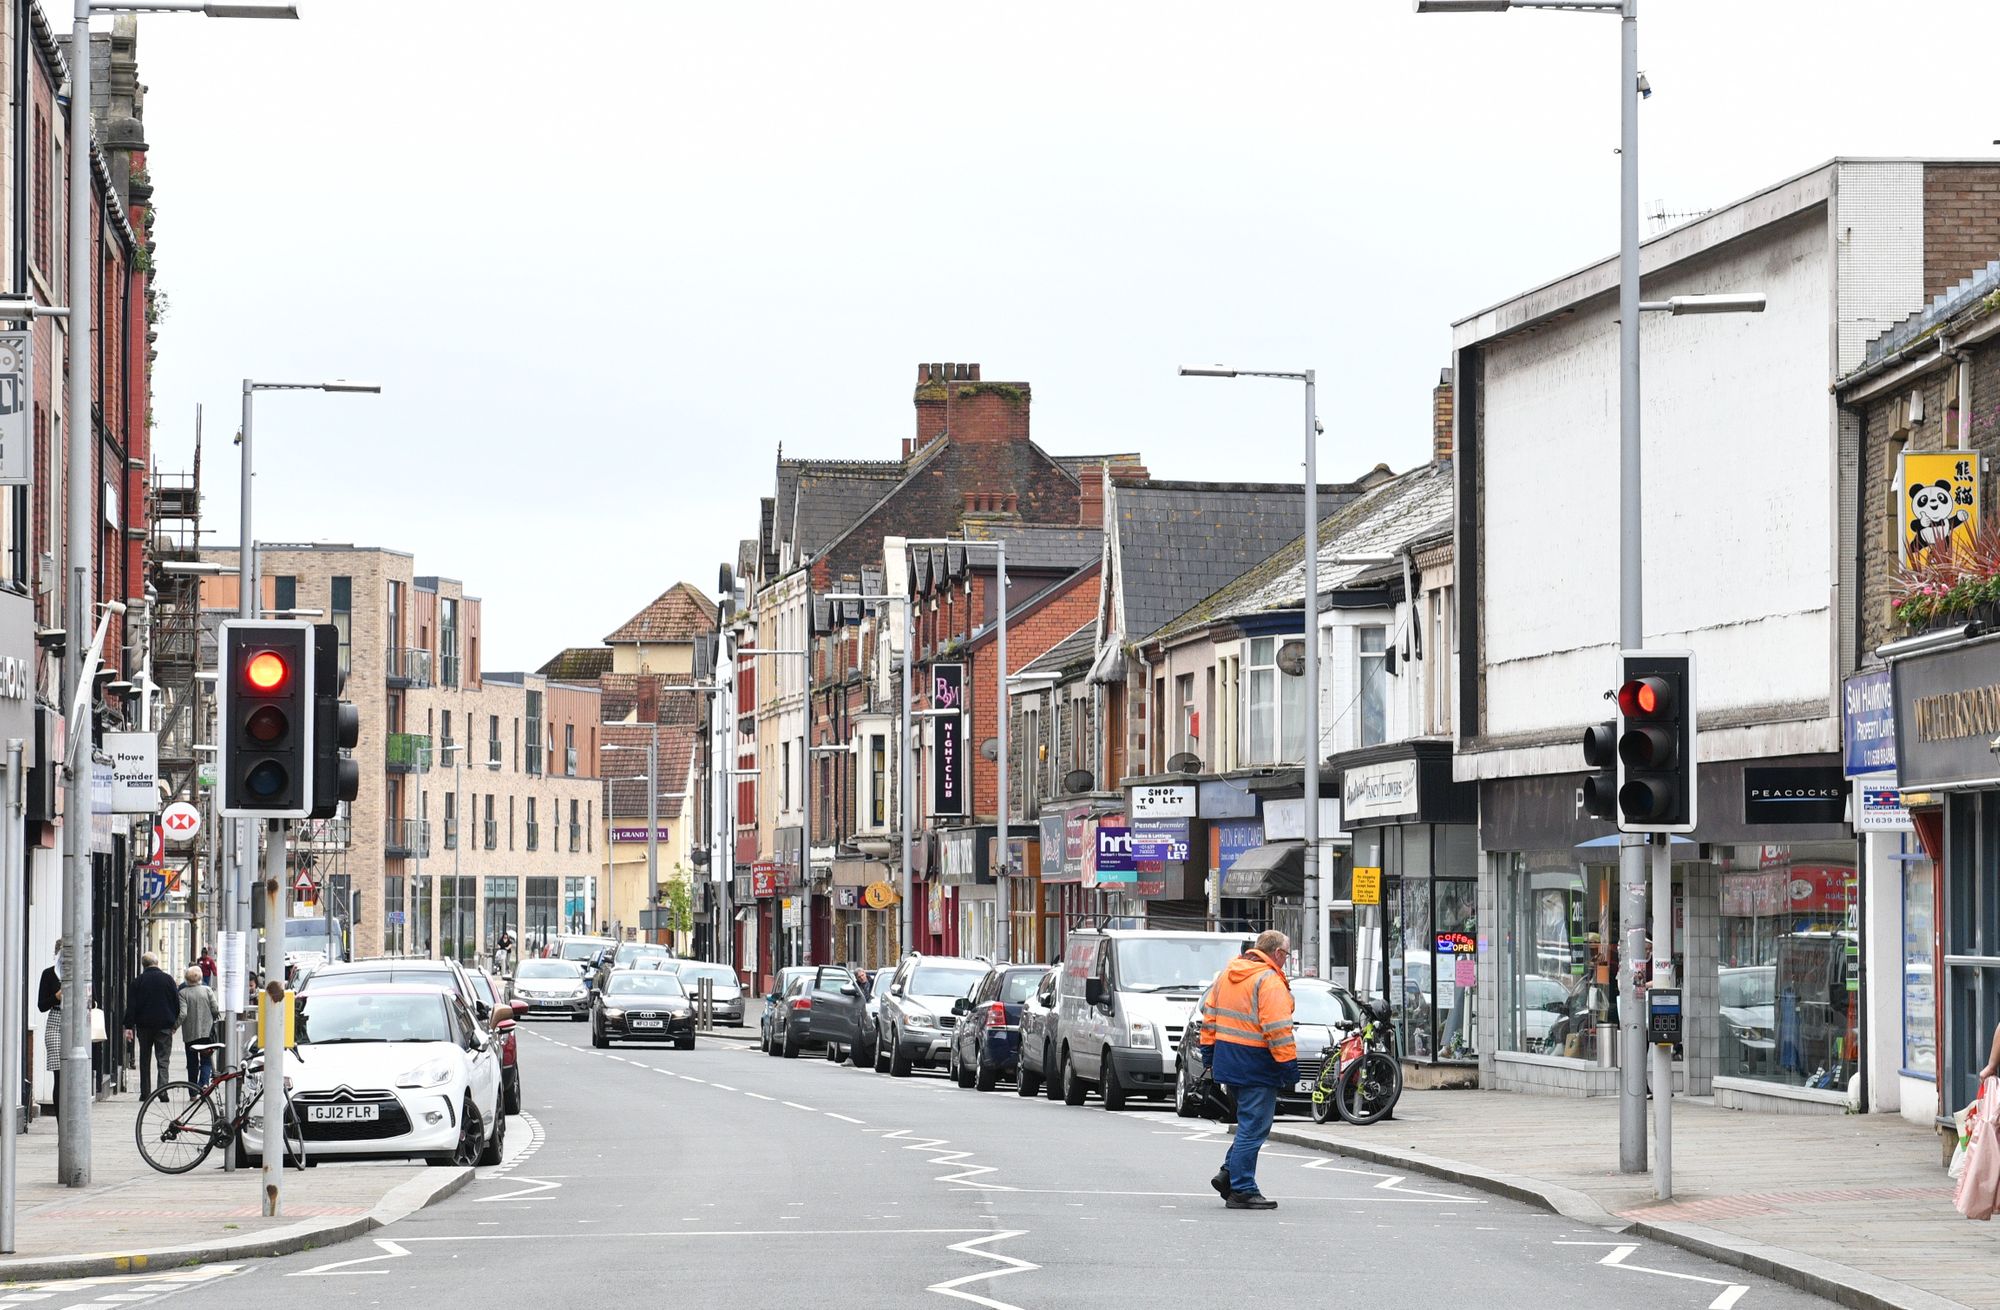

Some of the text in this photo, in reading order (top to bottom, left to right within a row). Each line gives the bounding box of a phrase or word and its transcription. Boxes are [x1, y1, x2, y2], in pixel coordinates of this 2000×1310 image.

[1847, 685, 1861, 715] SAM
[1856, 720, 1879, 741] PROPERTY
[117, 753, 145, 761] Howe
[944, 723, 952, 798] NIGHTCLUB
[113, 772, 154, 782] Spender
[1147, 788, 1175, 797] SHOP
[1751, 789, 1839, 797] PEACOCKS
[1139, 796, 1184, 805] TO LET
[1173, 843, 1188, 851] TO
[1167, 850, 1187, 860] LET
[1452, 943, 1474, 952] OPEN
[316, 1106, 371, 1119] GJ12 FLR
